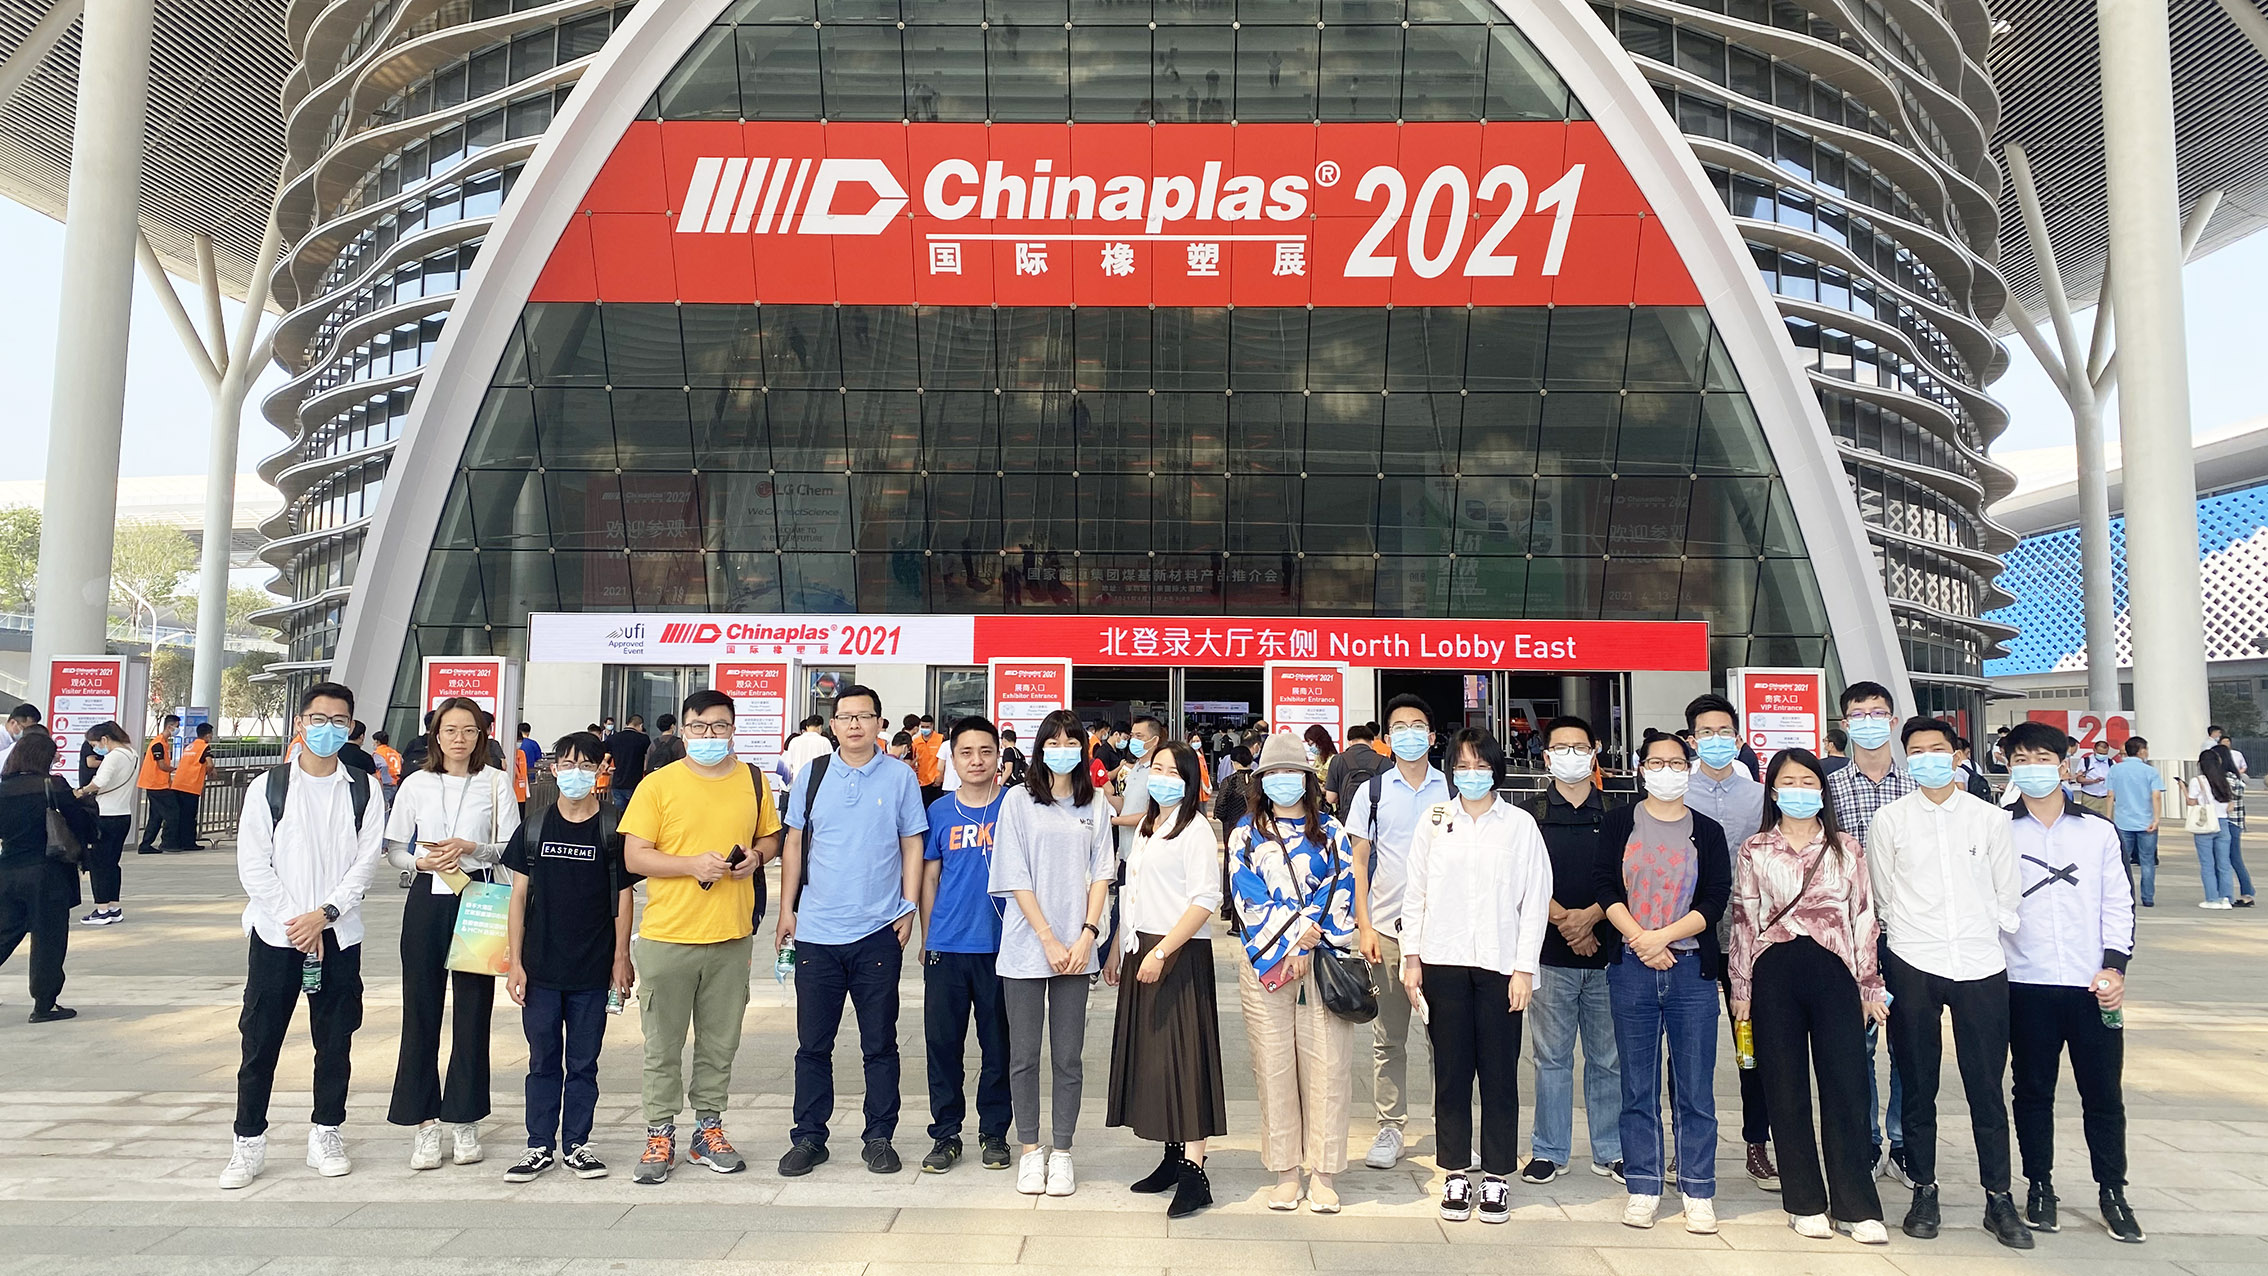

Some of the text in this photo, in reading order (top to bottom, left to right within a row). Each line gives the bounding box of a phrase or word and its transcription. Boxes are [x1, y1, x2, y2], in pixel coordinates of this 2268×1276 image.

[1343, 163, 1586, 279] 2021
[929, 242, 1306, 277] 国际橡塑展
[797, 483, 833, 496] Chem
[608, 640, 644, 648] Approved
[624, 623, 645, 639] ufi
[838, 625, 901, 656] 2021
[1099, 626, 1318, 658] 北登录大厅东侧
[1329, 632, 1577, 665] North Lobby East
[544, 845, 592, 857] EASTREME
